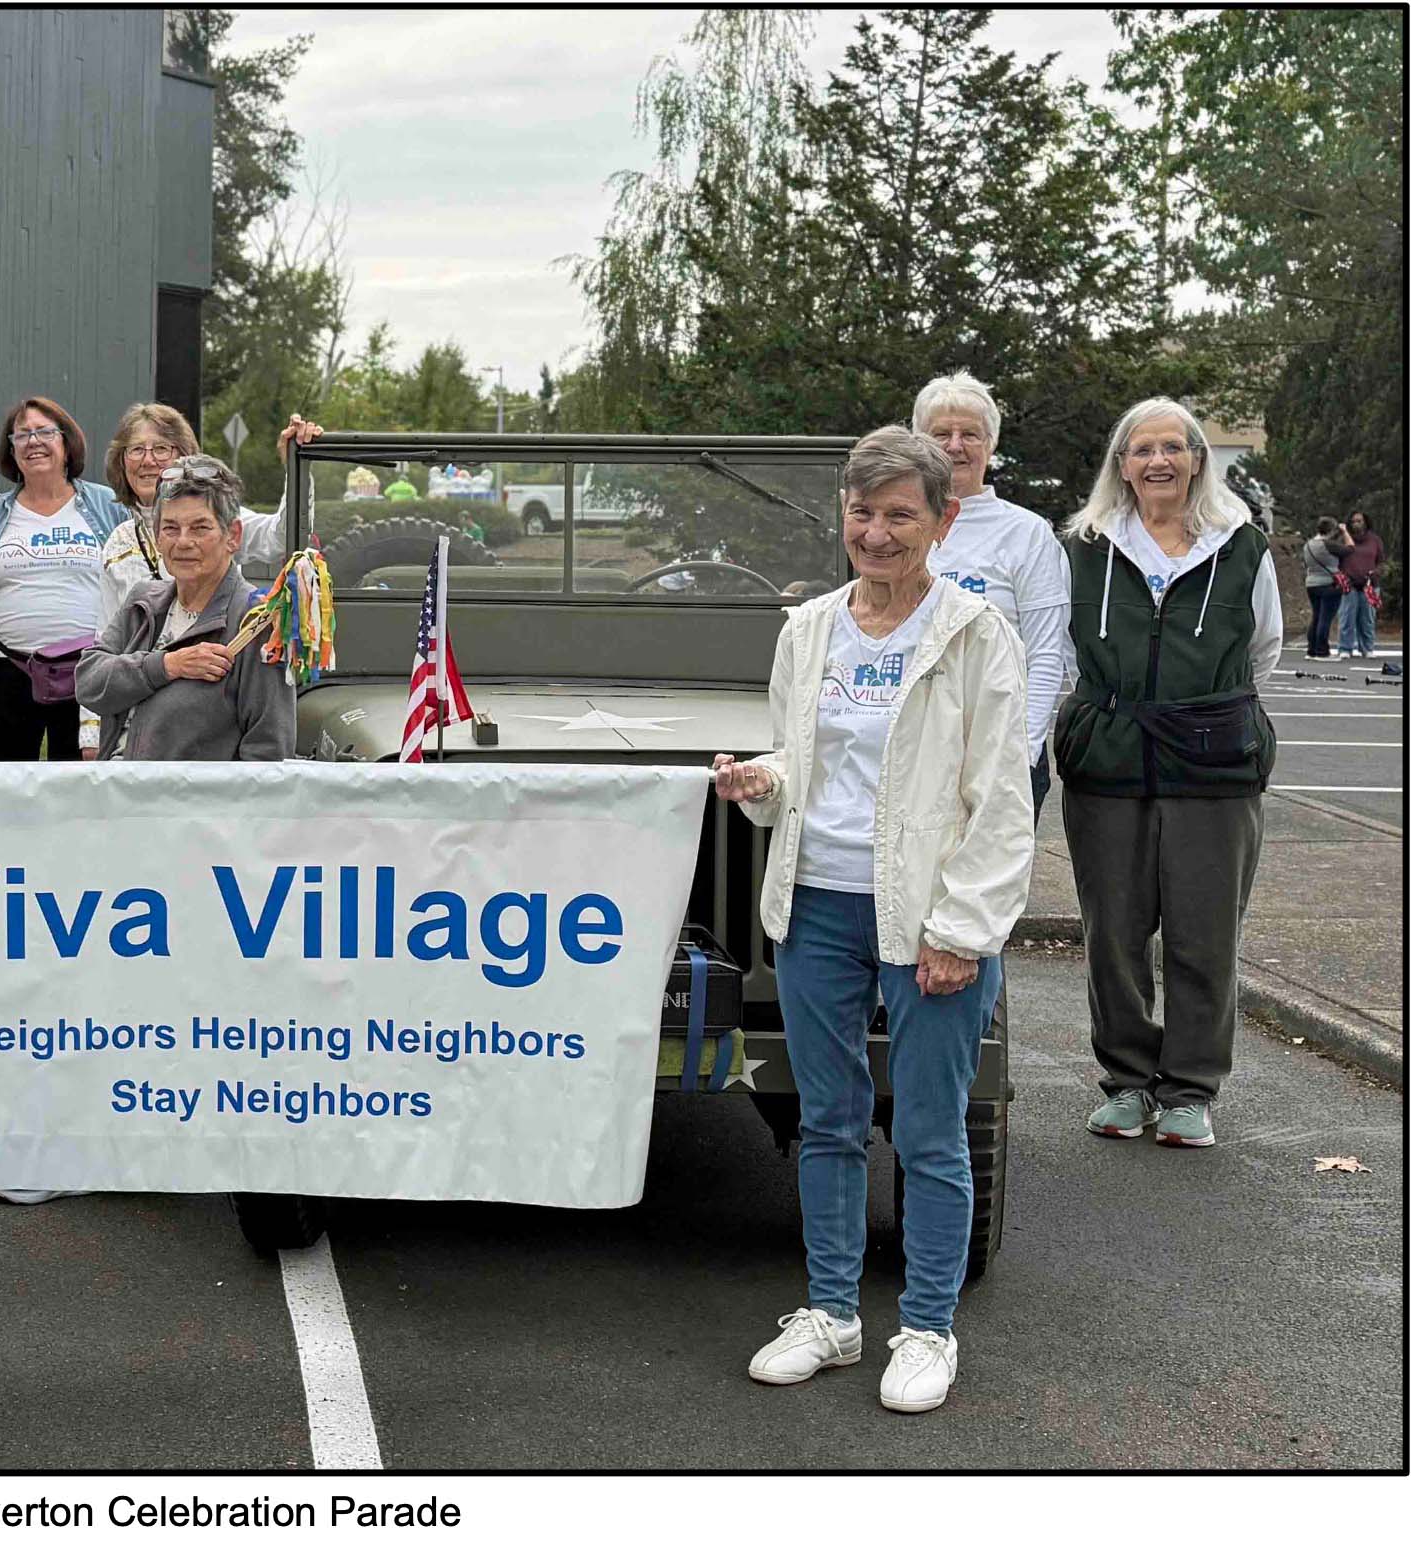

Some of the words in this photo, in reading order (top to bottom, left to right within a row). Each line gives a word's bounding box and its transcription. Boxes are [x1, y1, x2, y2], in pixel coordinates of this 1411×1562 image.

[213, 865, 624, 988] Village
[191, 1016, 352, 1061] Helping
[367, 1019, 586, 1064] Neighbors
[111, 1078, 200, 1123] Stay
[218, 1080, 434, 1124] Neighbors
